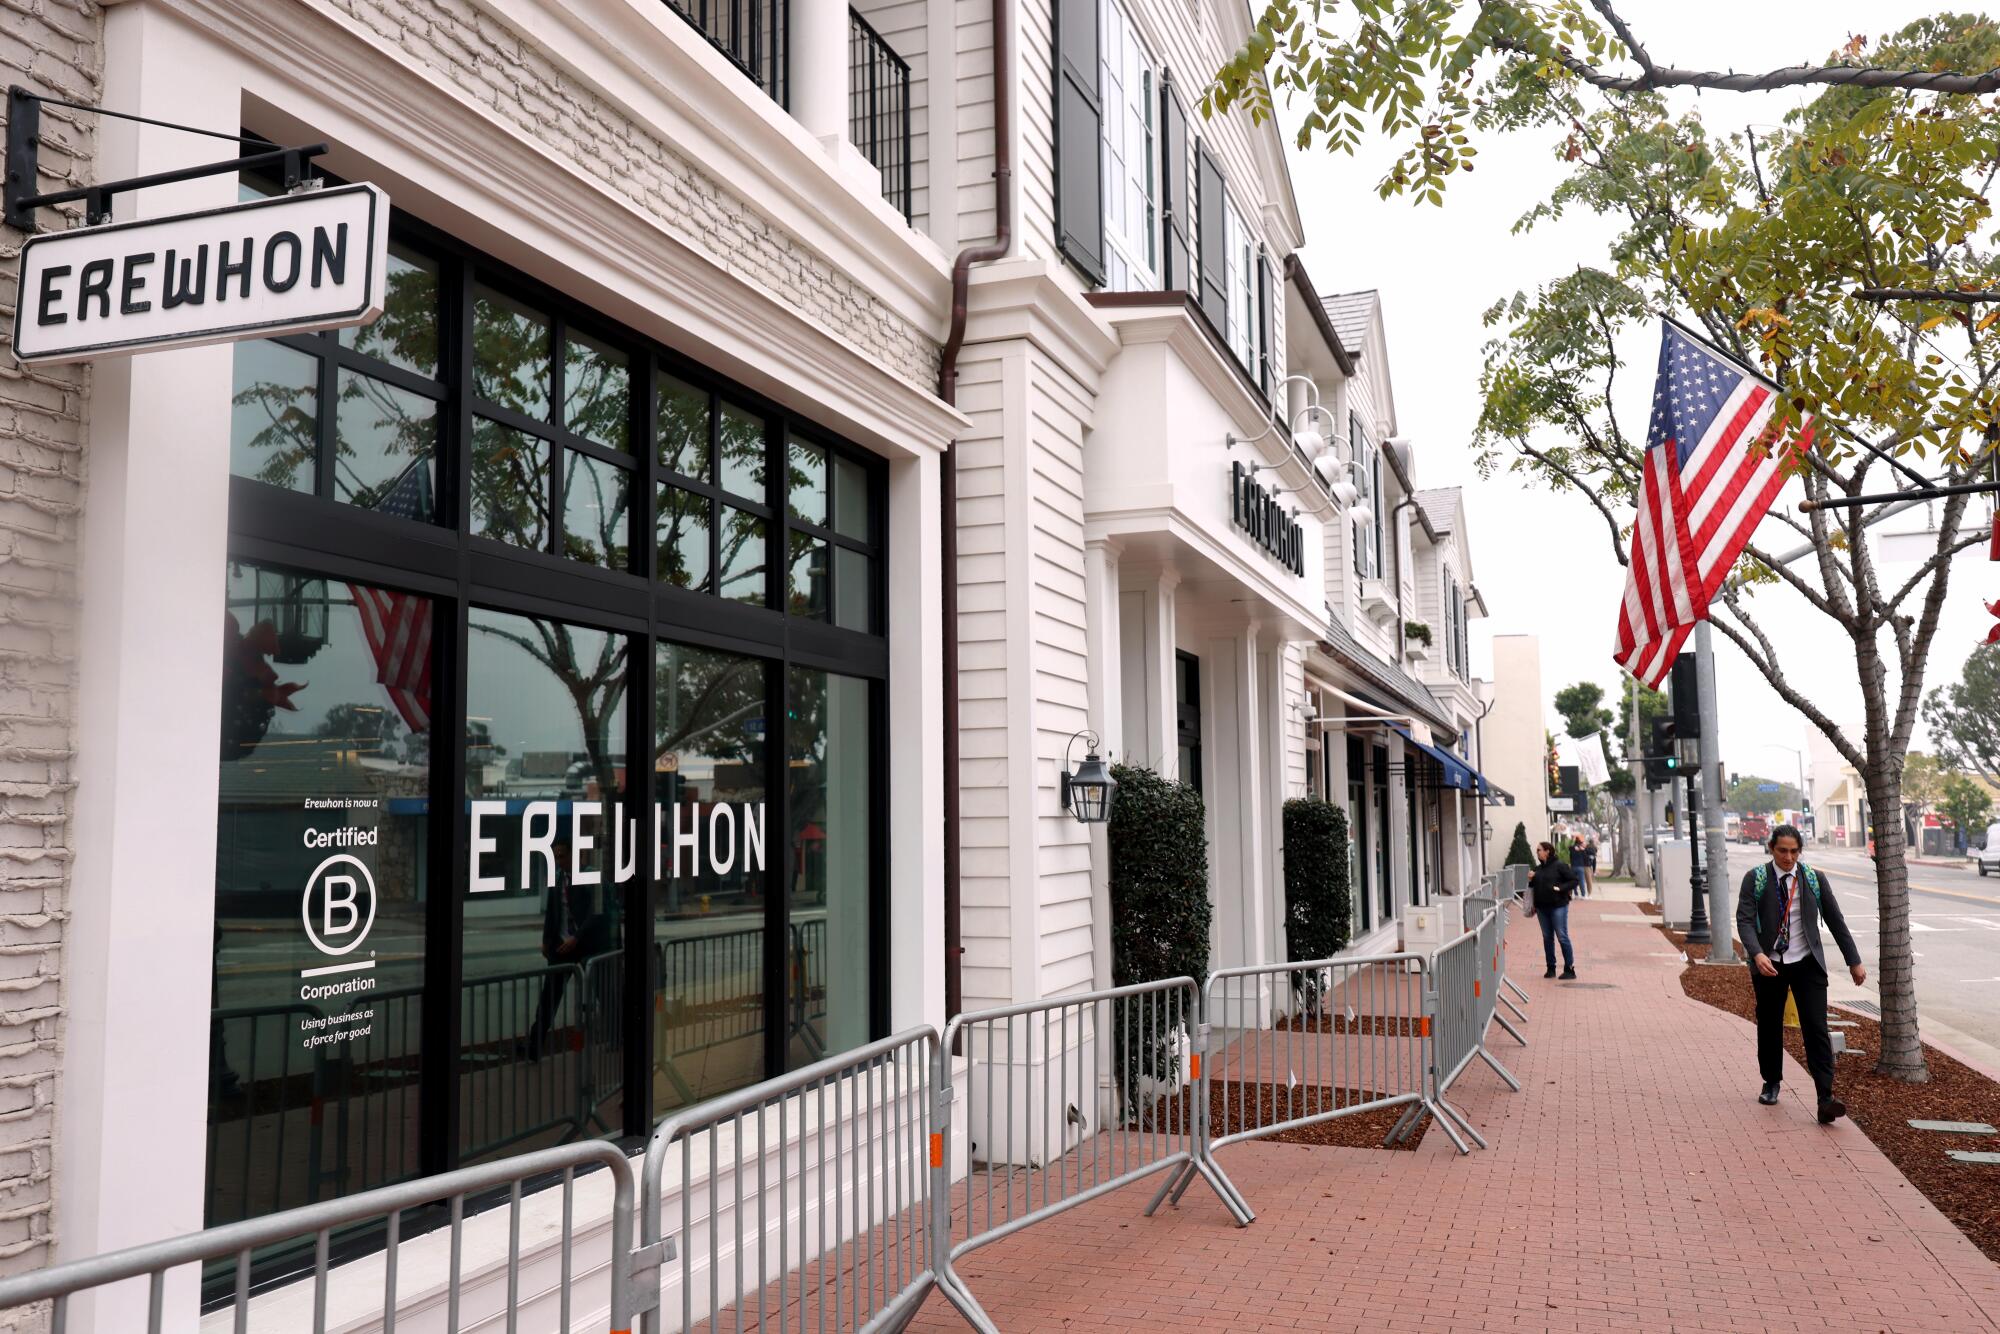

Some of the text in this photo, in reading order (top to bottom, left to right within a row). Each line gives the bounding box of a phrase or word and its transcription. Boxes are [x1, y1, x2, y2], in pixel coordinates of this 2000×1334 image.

[38, 222, 348, 326] EREWHON
[1232, 460, 1305, 578] EREWHON
[304, 797, 378, 809] Erewhon is now a
[303, 826, 378, 849] Certified
[469, 800, 766, 893] EREWHON
[324, 875, 359, 936] B
[300, 977, 376, 1000] Corporation
[301, 1009, 374, 1030] Using business as
[303, 1024, 371, 1049] a force for good
